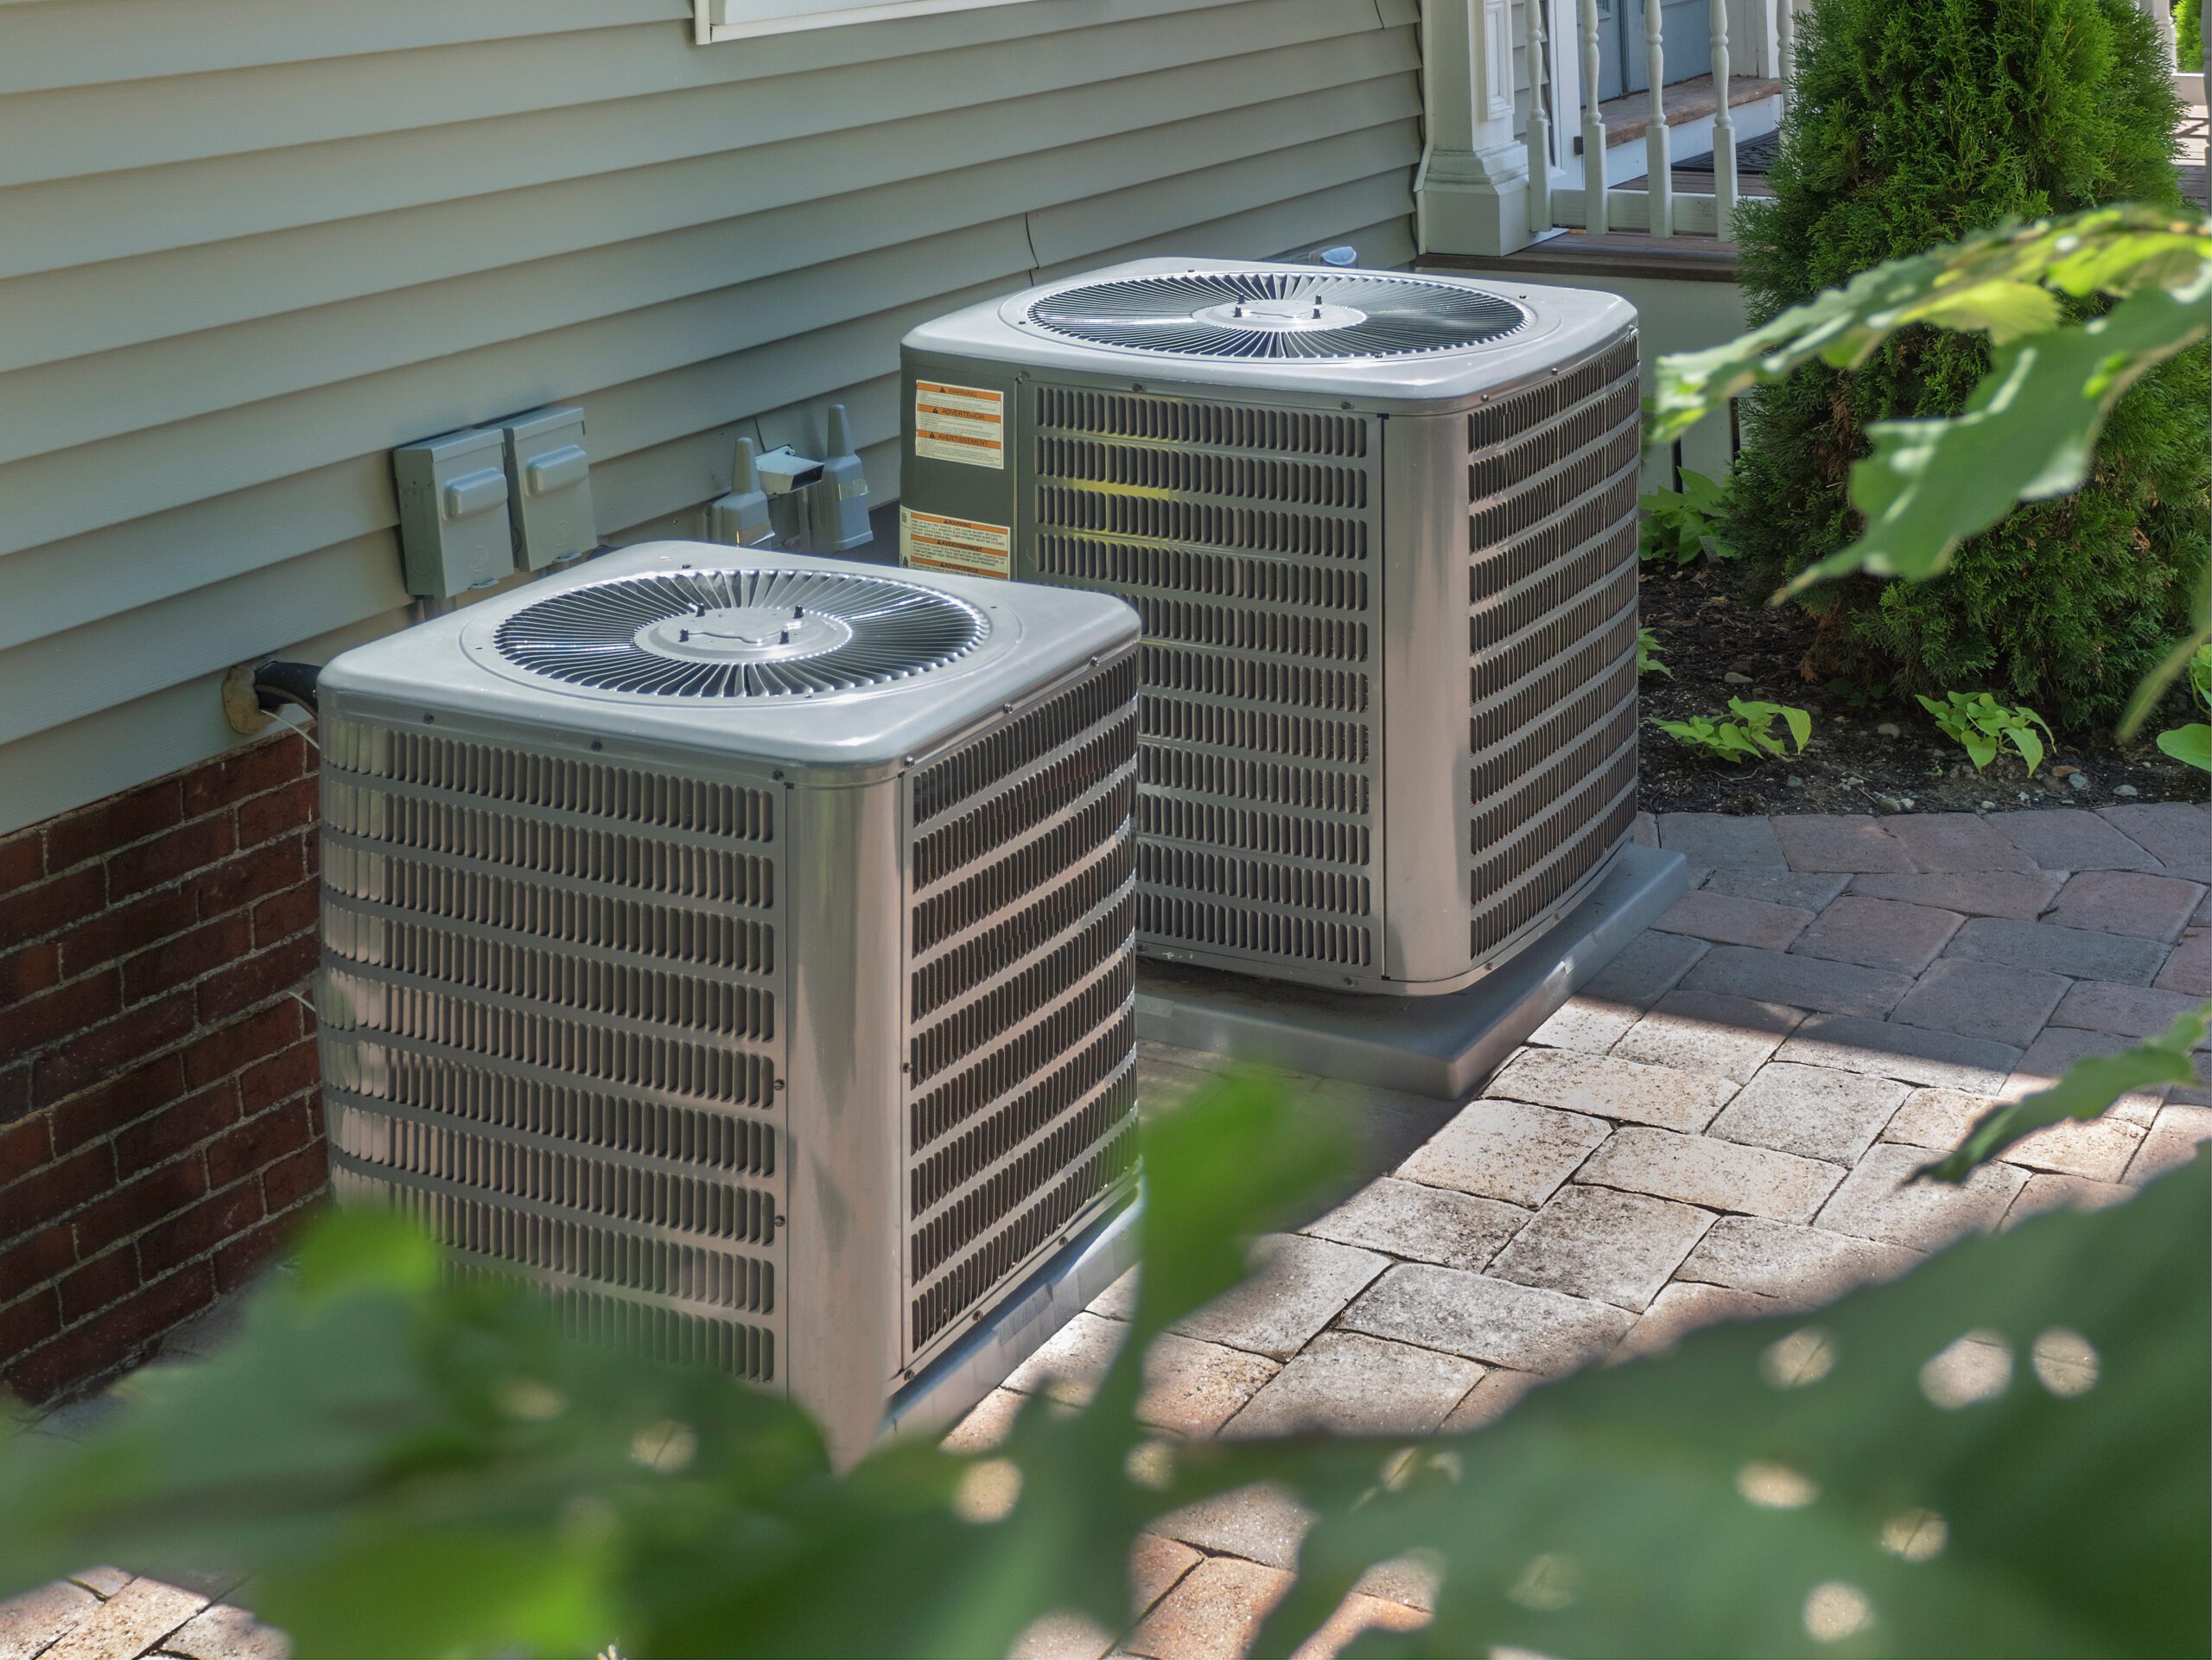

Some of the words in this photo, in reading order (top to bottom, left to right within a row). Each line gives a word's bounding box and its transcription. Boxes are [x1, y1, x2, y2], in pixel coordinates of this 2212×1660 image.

[948, 387, 977, 398] WARNING
[942, 408, 985, 419] ADVERTENCIA
[938, 434, 988, 446] AVERTISSEMENT
